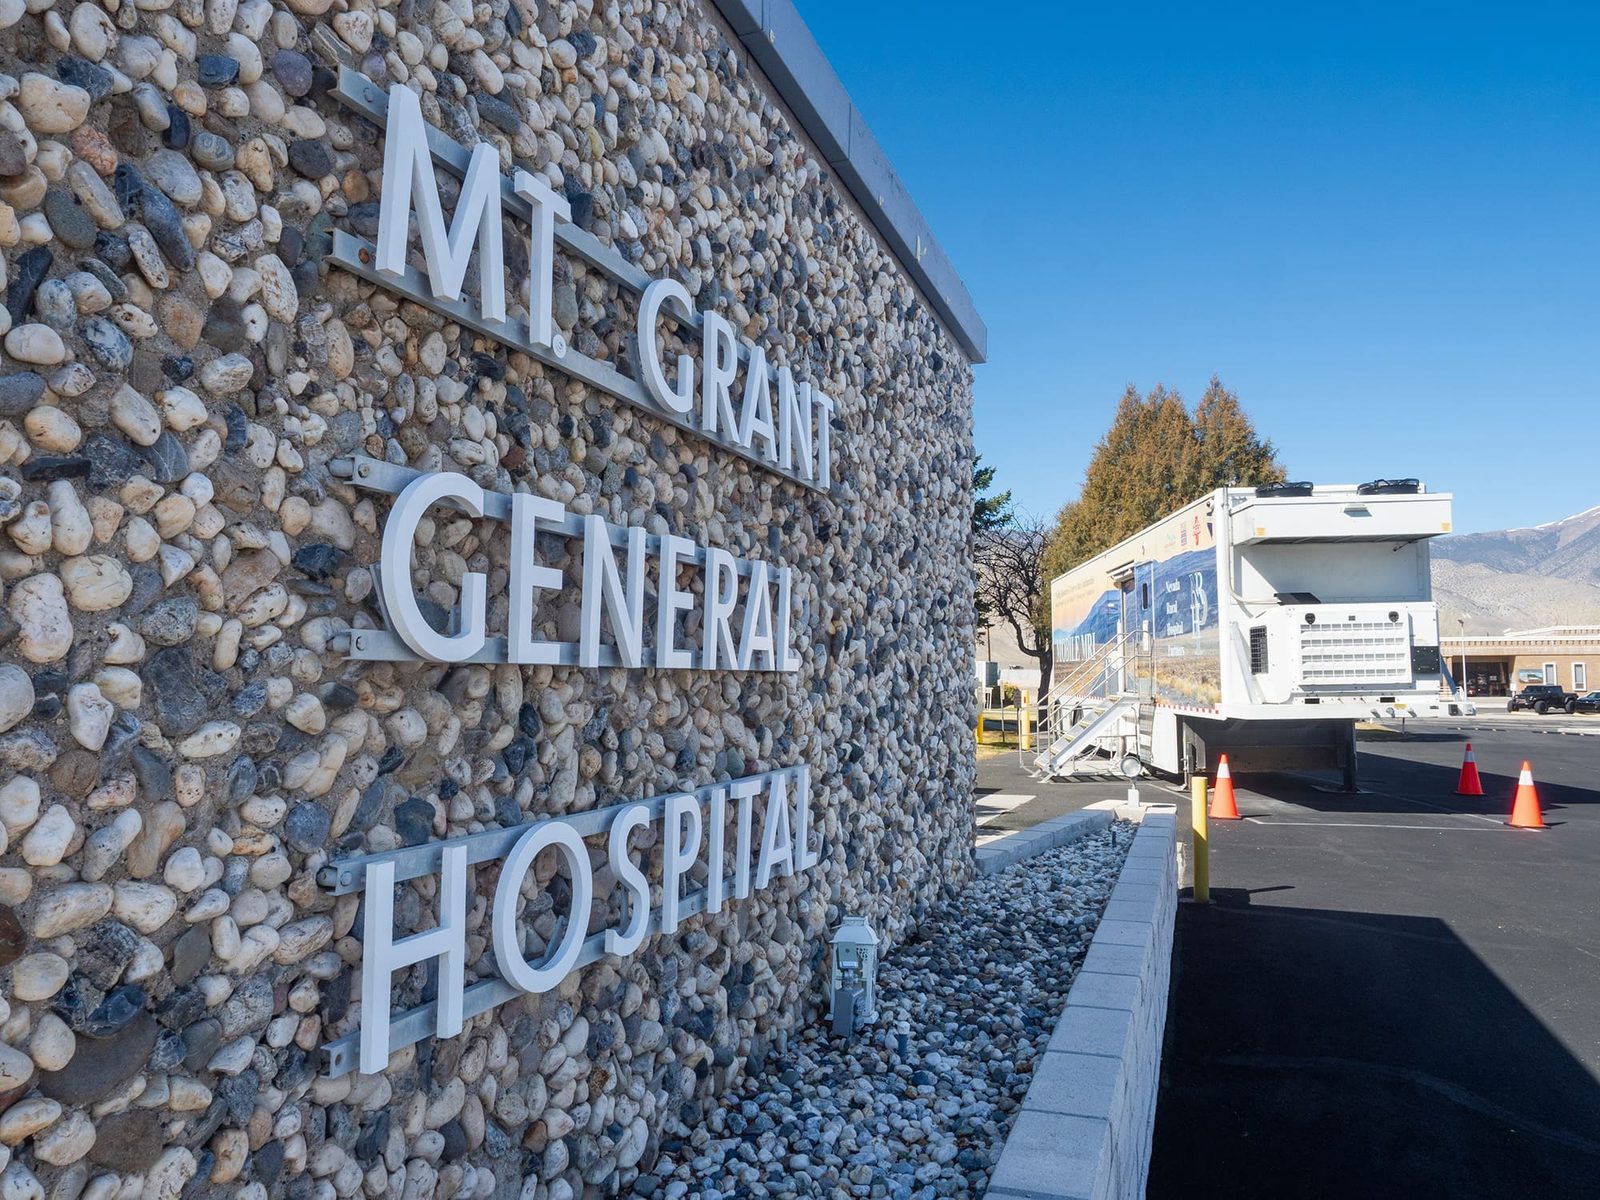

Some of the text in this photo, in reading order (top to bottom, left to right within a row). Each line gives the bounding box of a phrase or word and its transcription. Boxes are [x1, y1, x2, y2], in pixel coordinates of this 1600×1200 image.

[376, 84, 834, 490] MT. GRANT
[381, 472, 800, 672] GENERAL
[360, 764, 818, 1075] HOSPITAL
